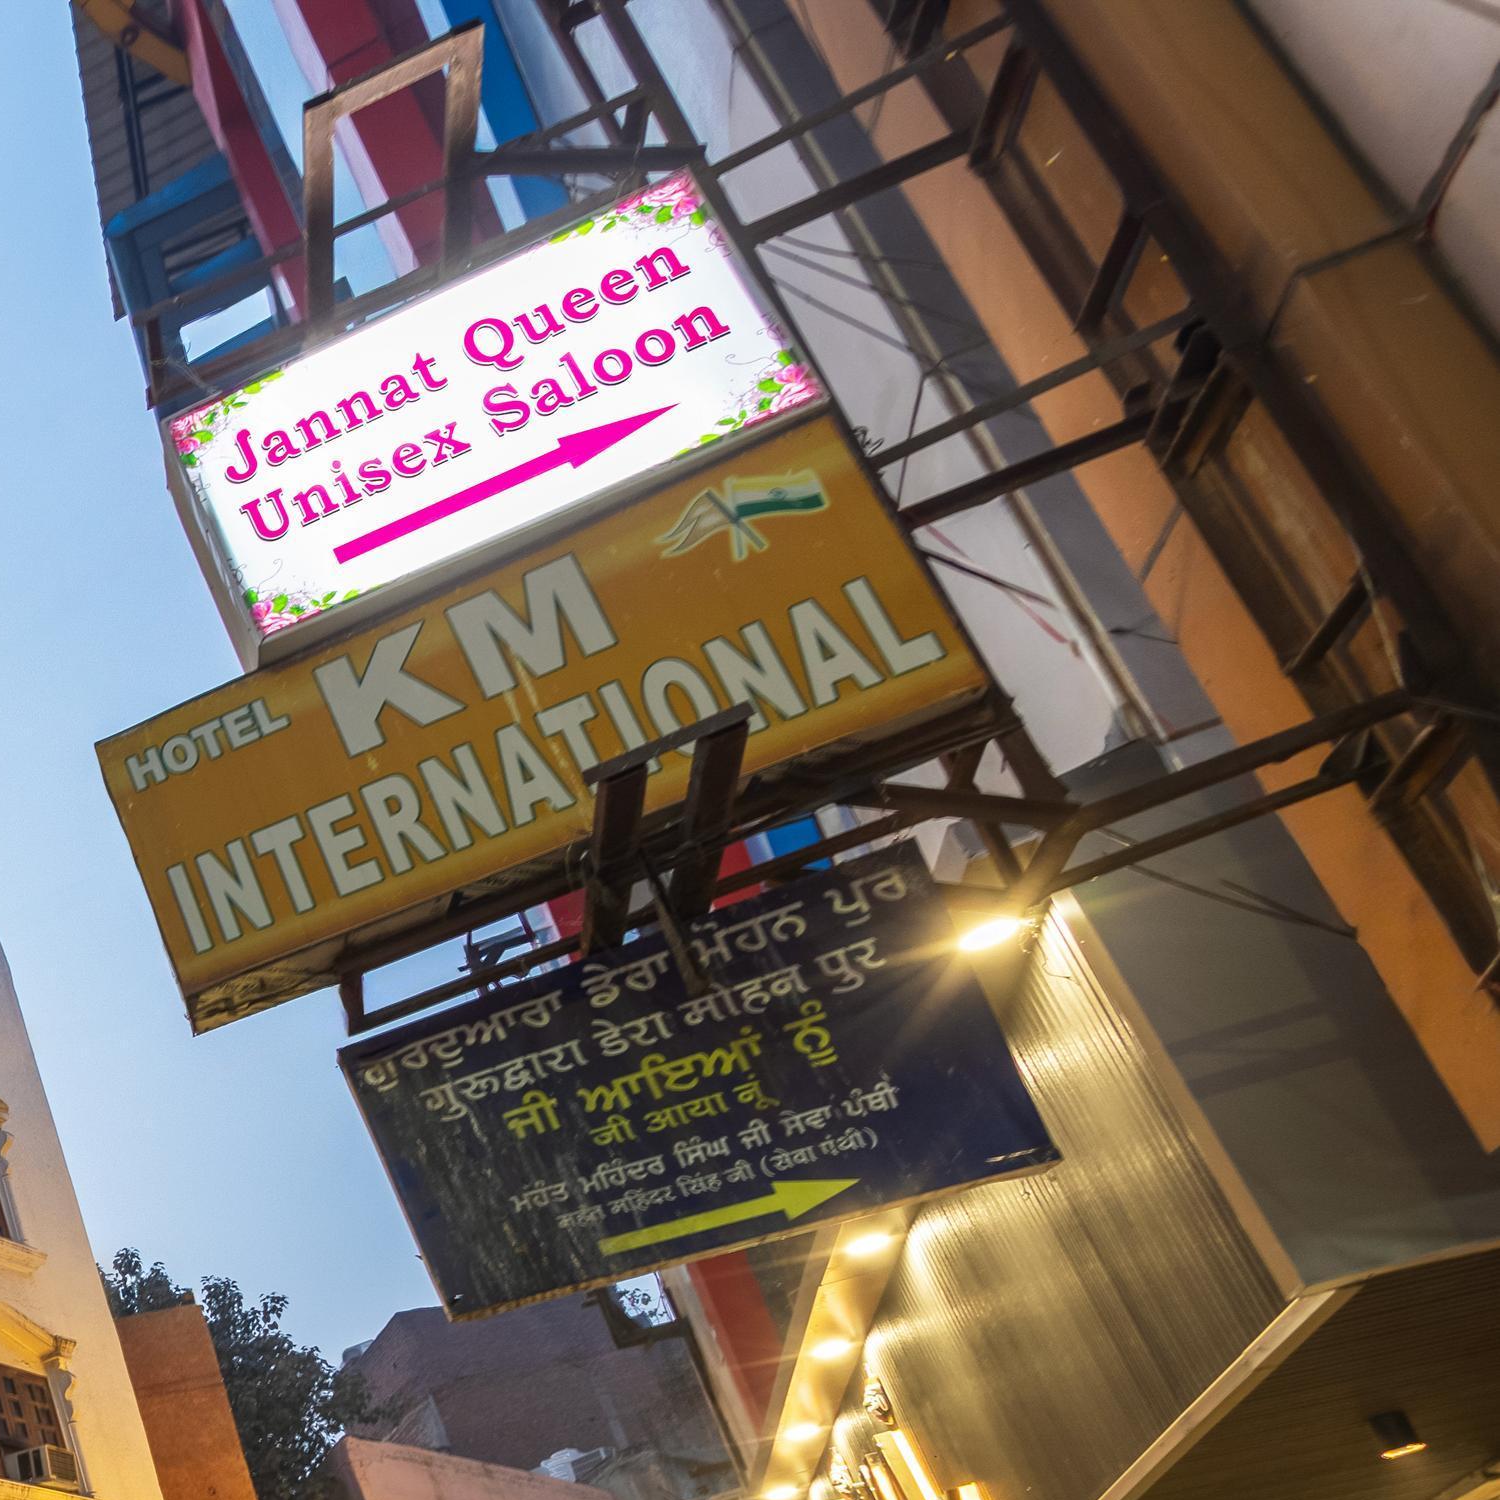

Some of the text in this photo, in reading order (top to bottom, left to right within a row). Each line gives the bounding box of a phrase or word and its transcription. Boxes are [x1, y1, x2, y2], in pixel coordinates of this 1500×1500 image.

[225, 246, 691, 483] Jannat Queen
[241, 305, 731, 540] Unisex Saloon
[125, 553, 617, 792] HOTEL KM
[167, 575, 947, 955] INTERNATIONAL
[591, 1011, 673, 1057] डेरा
[814, 937, 887, 994] पुर
[504, 1090, 561, 1139] ਜੀ
[590, 1115, 637, 1146] जी
[646, 1091, 729, 1133] आया
[737, 1118, 772, 1150] ਜੀ
